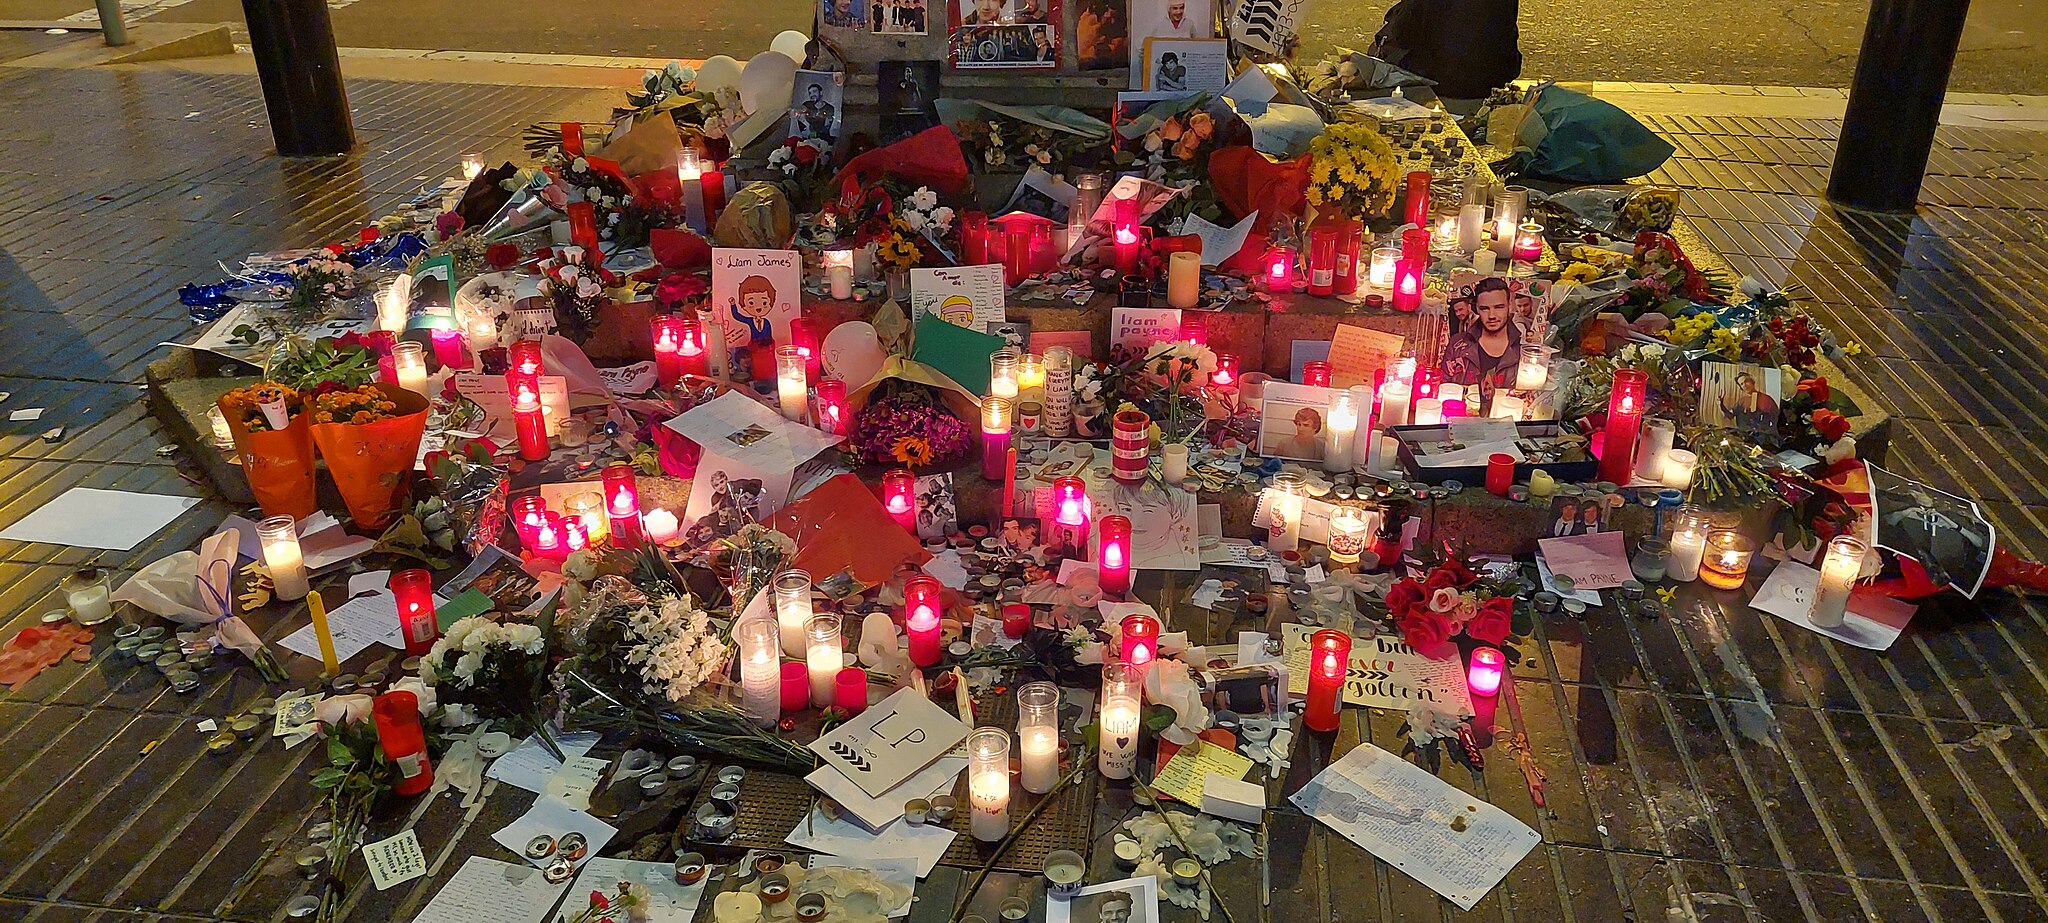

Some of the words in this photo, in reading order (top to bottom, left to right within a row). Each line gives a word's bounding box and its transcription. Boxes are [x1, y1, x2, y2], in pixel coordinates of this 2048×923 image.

[727, 254, 752, 269] Liam
[757, 254, 791, 268] James
[1121, 313, 1157, 326] liam
[1120, 327, 1171, 338] payne
[1574, 577, 1588, 585] AM
[1589, 573, 1621, 585] PAYNE
[1348, 658, 1401, 673] ever
[1105, 716, 1137, 734] LIAM
[1102, 749, 1114, 759] WE
[1106, 760, 1125, 769] MISS
